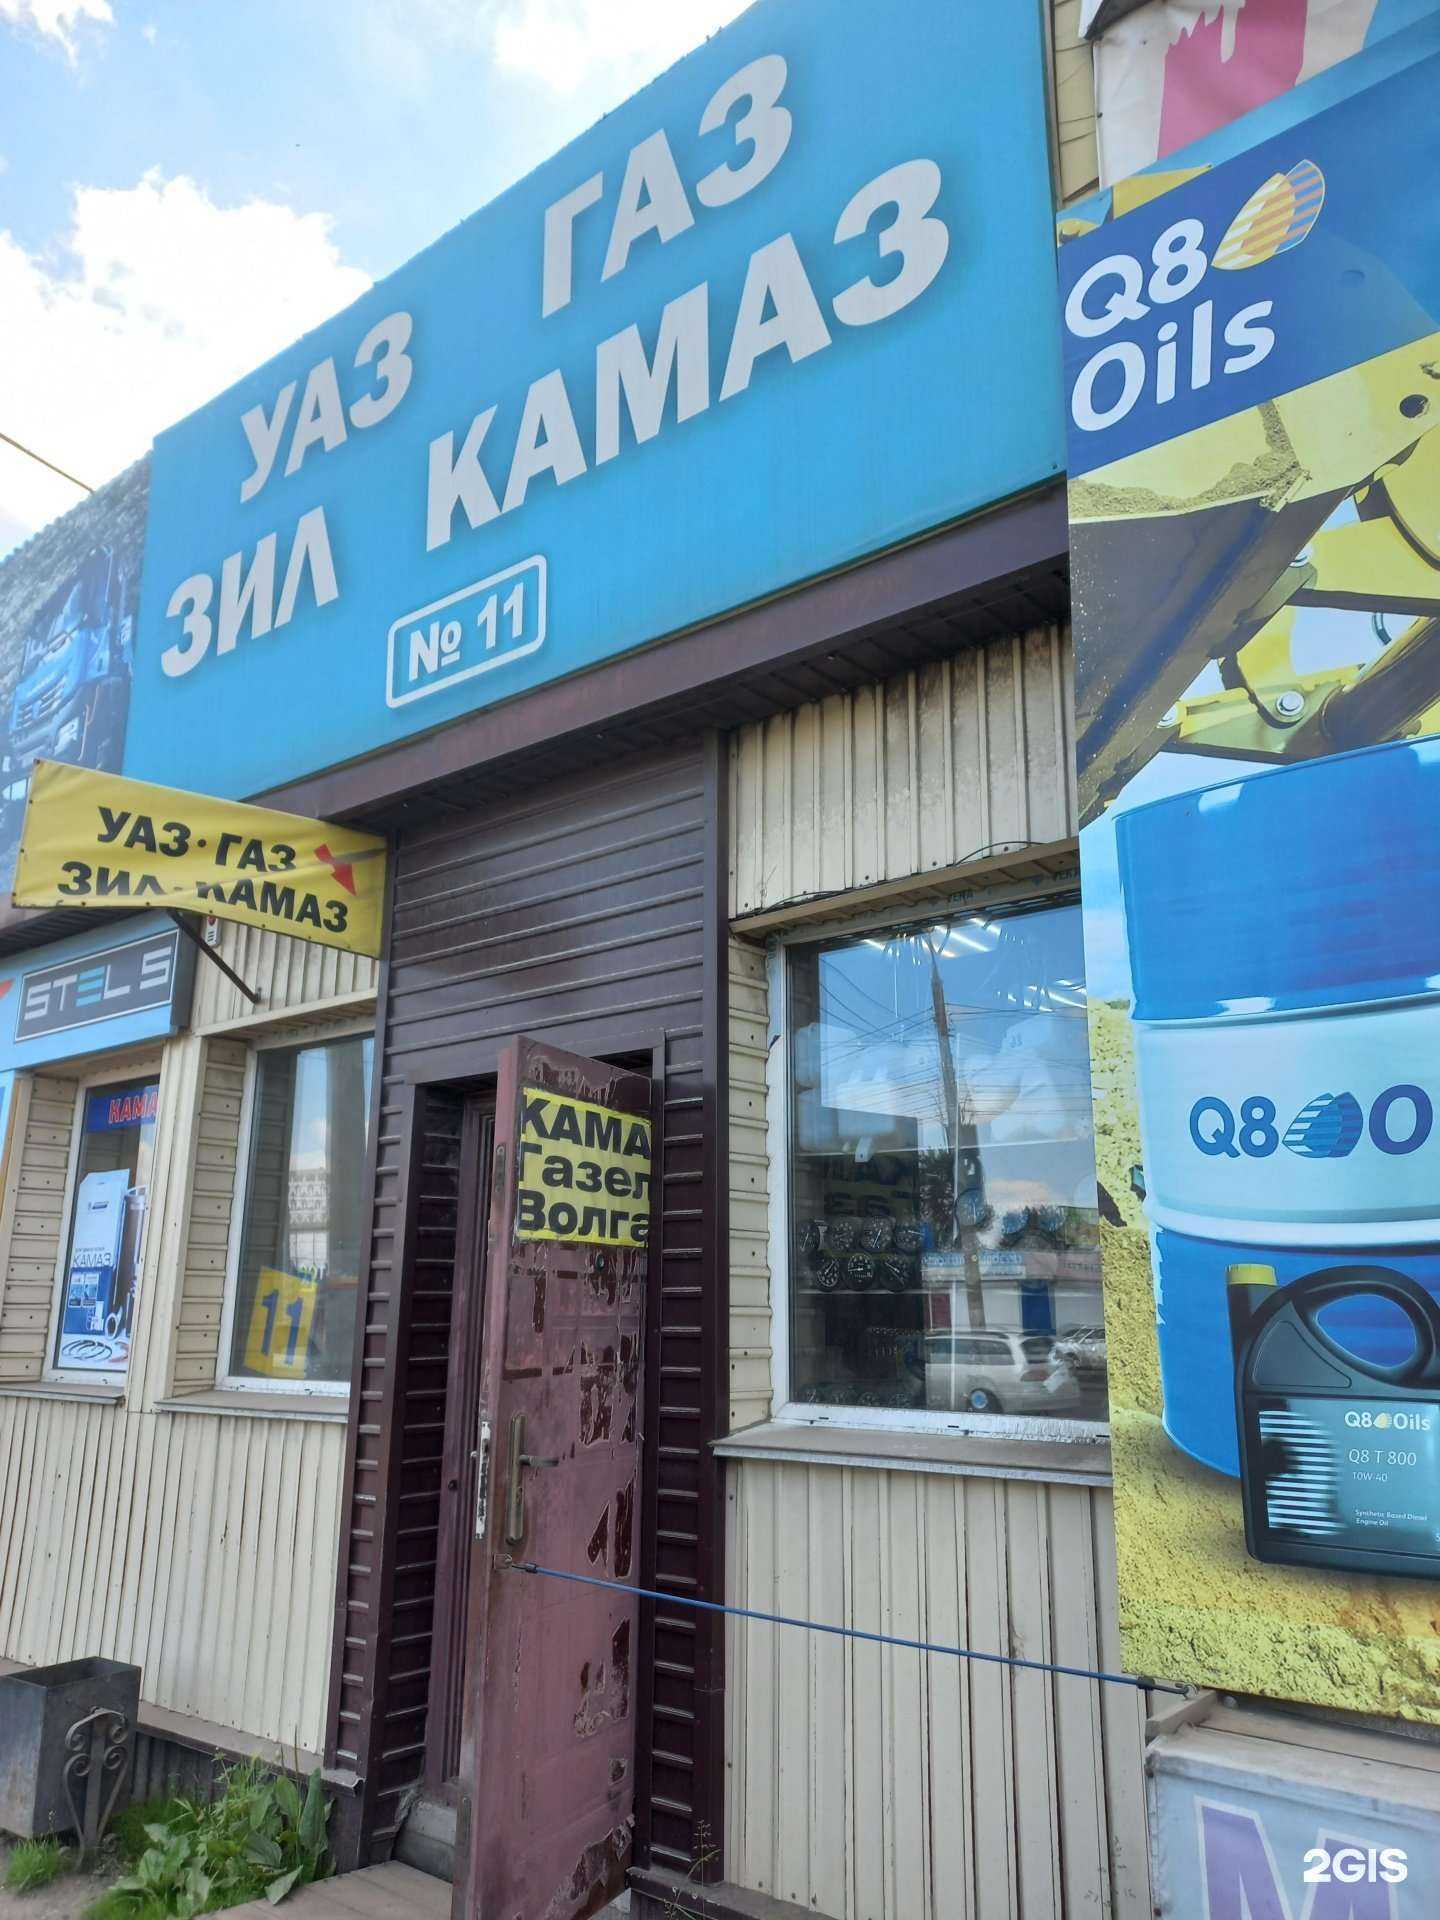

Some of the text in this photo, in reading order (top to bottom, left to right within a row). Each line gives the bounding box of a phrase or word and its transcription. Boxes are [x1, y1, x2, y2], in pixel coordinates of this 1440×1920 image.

[542, 53, 792, 319] ГАЗ
[1065, 218, 1208, 338] Q8
[426, 158, 949, 552] КАМАЗ
[1071, 300, 1275, 432] Oils
[240, 311, 413, 504] УАЗ
[160, 505, 339, 678] ЗИЛ
[477, 582, 524, 650] 11
[97, 806, 297, 872] УАЗ ГАЗ
[24, 946, 172, 1021] STELS
[1189, 1096, 1279, 1158] Q8
[262, 1289, 304, 1366] 11
[1344, 1411, 1431, 1431] Q8 Oils
[1348, 1448, 1417, 1466] Q8 T 800
